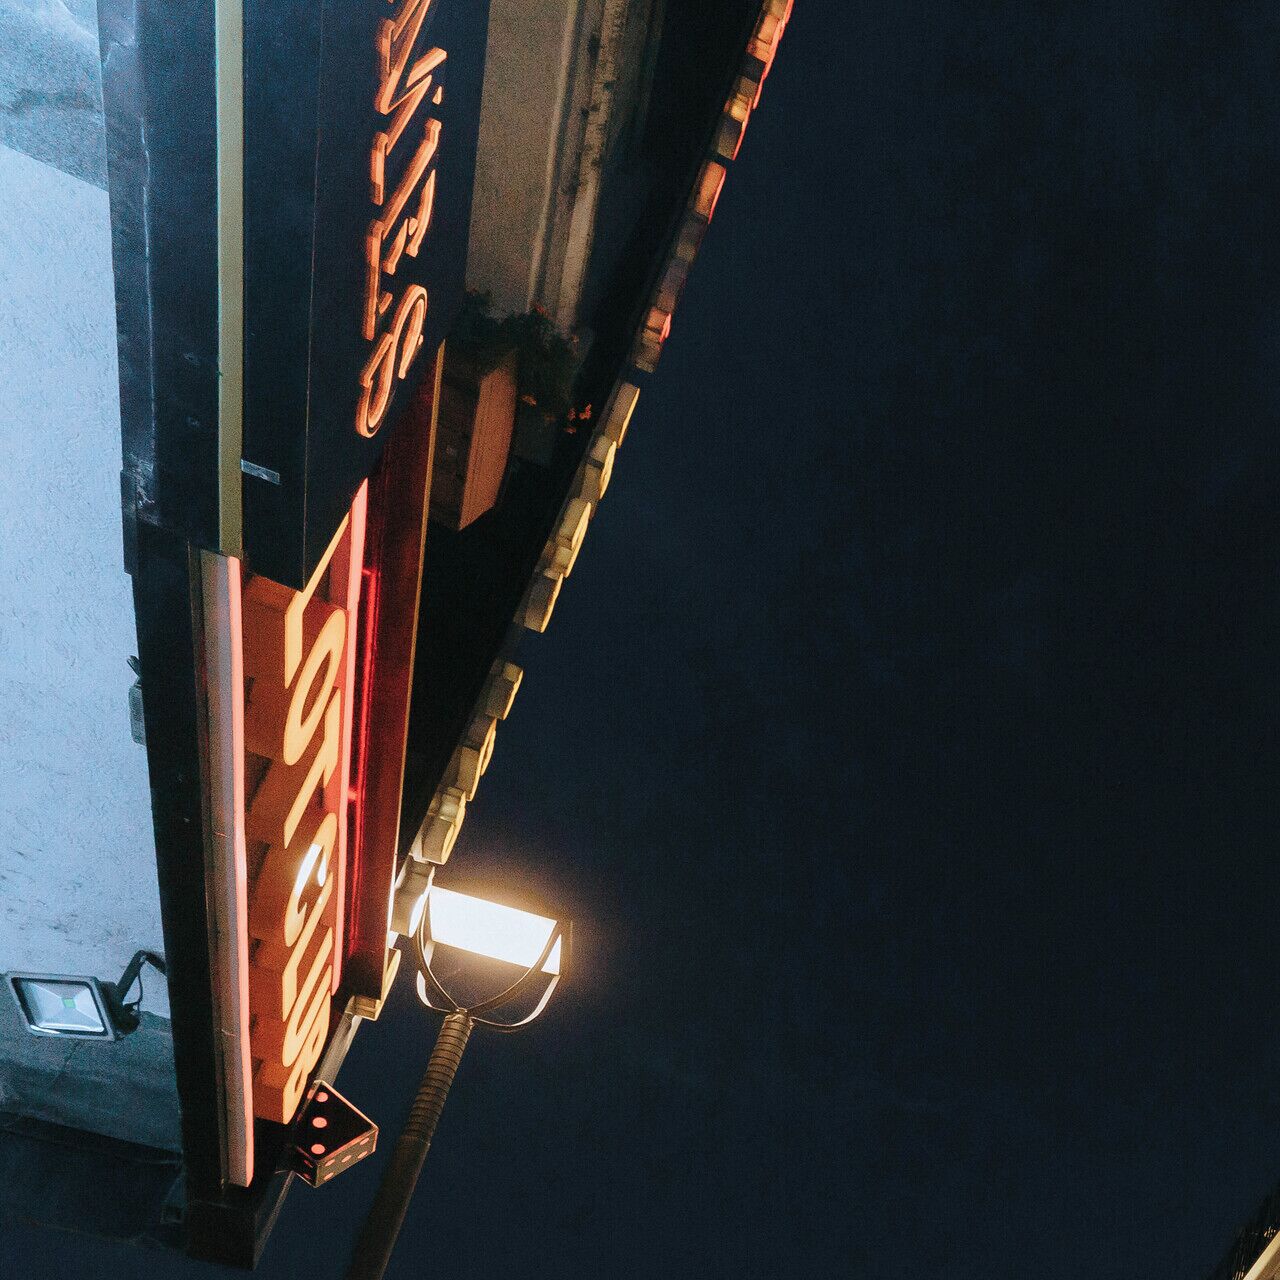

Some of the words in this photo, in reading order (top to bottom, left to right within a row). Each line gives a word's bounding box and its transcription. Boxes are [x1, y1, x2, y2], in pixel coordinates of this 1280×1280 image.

[355, 0, 448, 437] MES
[283, 511, 350, 848] LOT
[282, 810, 340, 1125] CLUB
